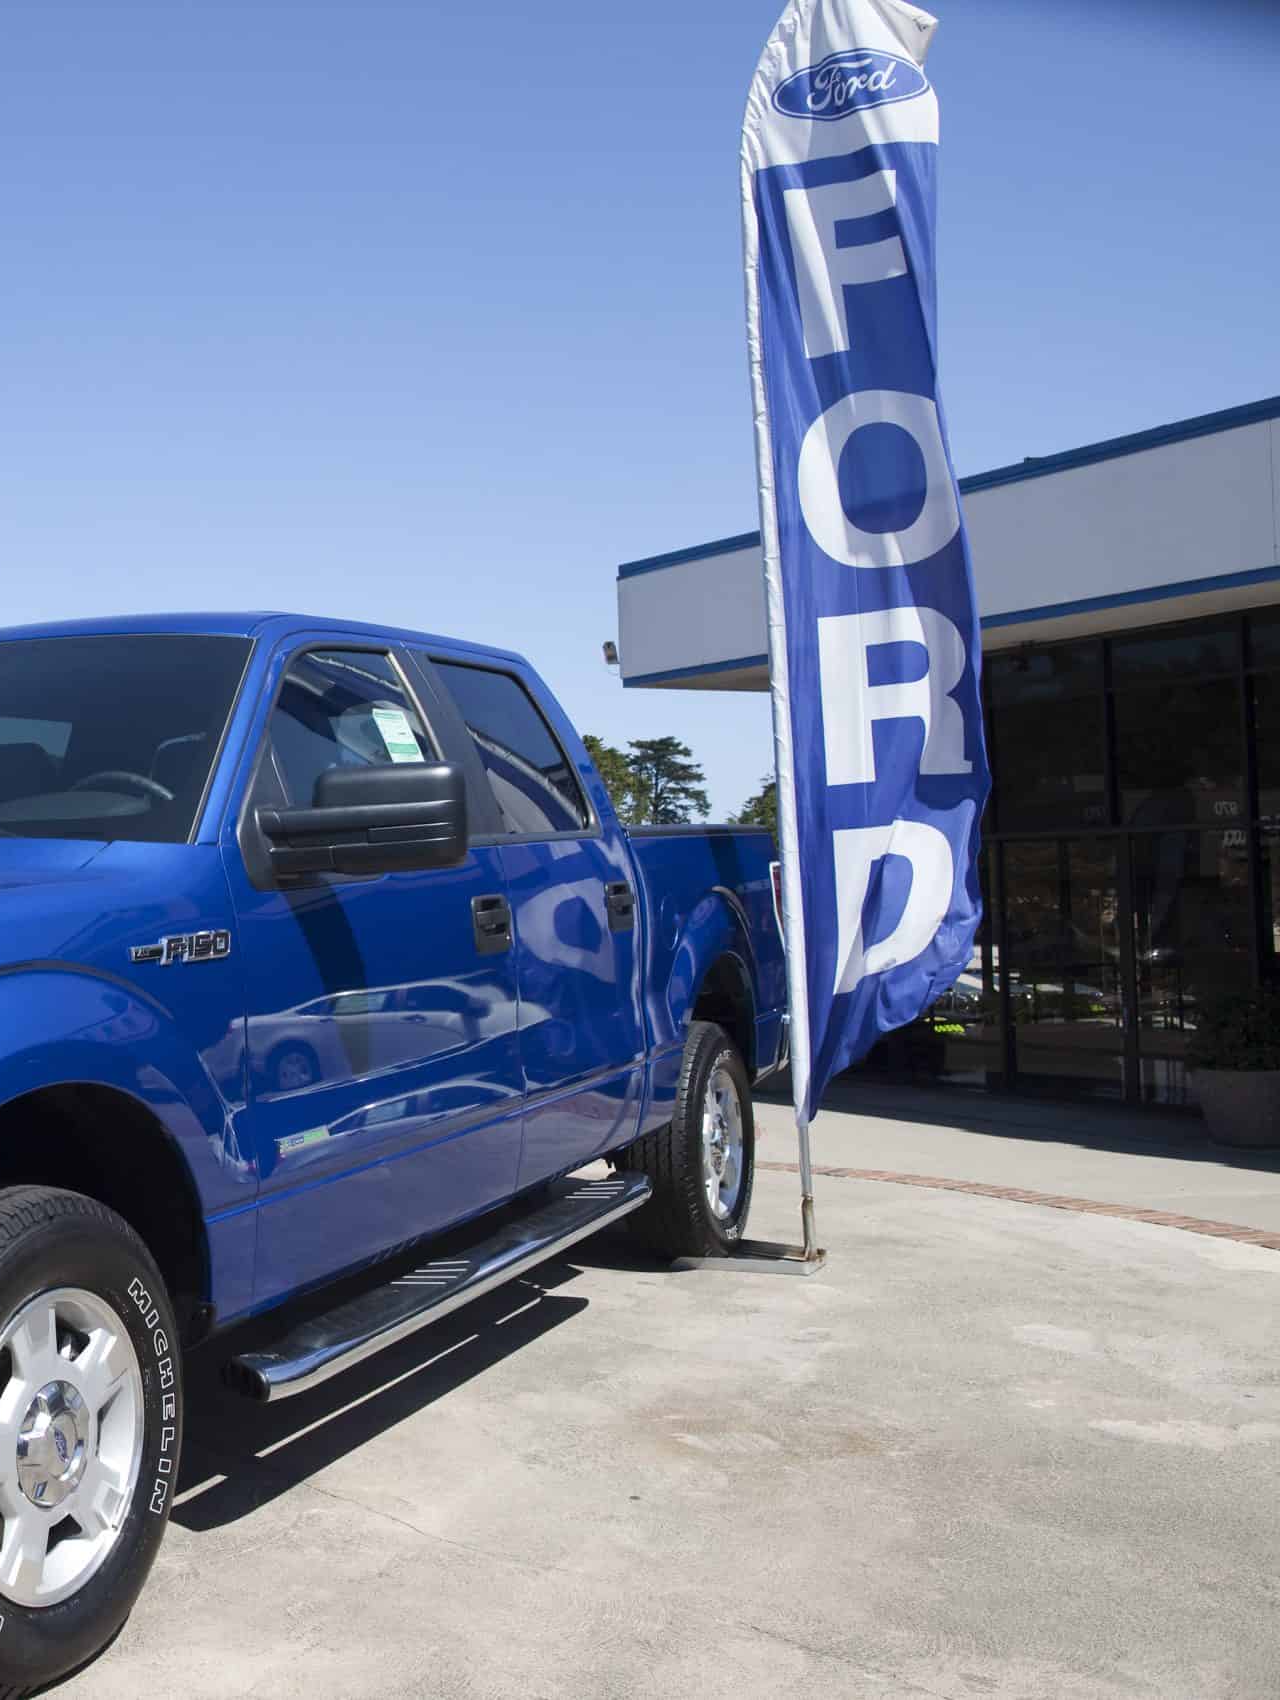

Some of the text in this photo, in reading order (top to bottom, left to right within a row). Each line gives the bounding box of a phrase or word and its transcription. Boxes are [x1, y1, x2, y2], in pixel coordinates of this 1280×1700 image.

[806, 58, 897, 112] Ford
[783, 168, 973, 995] FORD
[128, 1278, 176, 1515] MICHELIN
